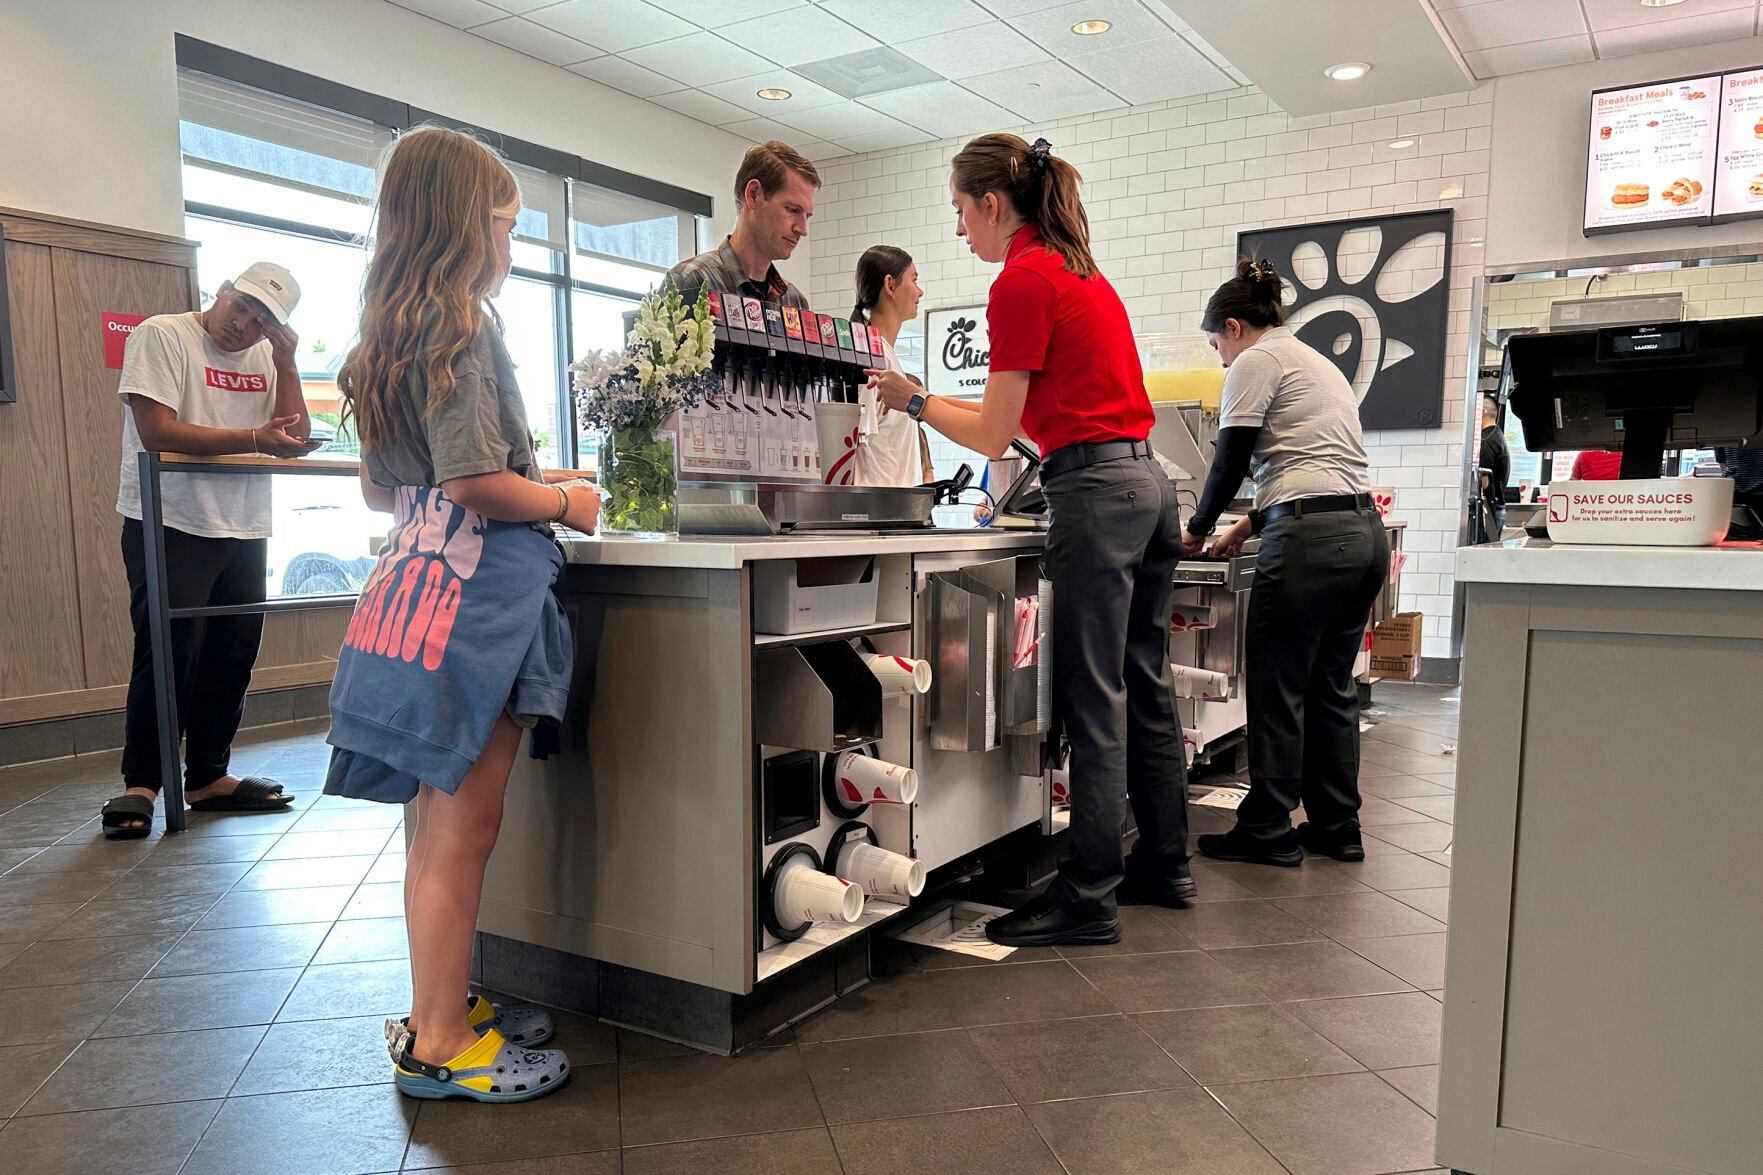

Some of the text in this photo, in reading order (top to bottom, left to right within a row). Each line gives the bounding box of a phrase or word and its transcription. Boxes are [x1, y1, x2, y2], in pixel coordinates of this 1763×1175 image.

[1598, 93, 1643, 107] Breakfast
[1646, 88, 1673, 99] Meals
[108, 321, 137, 333] Occu
[942, 330, 989, 371] Chic
[1574, 494, 1692, 504] SAVE OUR SAUCES
[1668, 515, 1696, 523] again!
